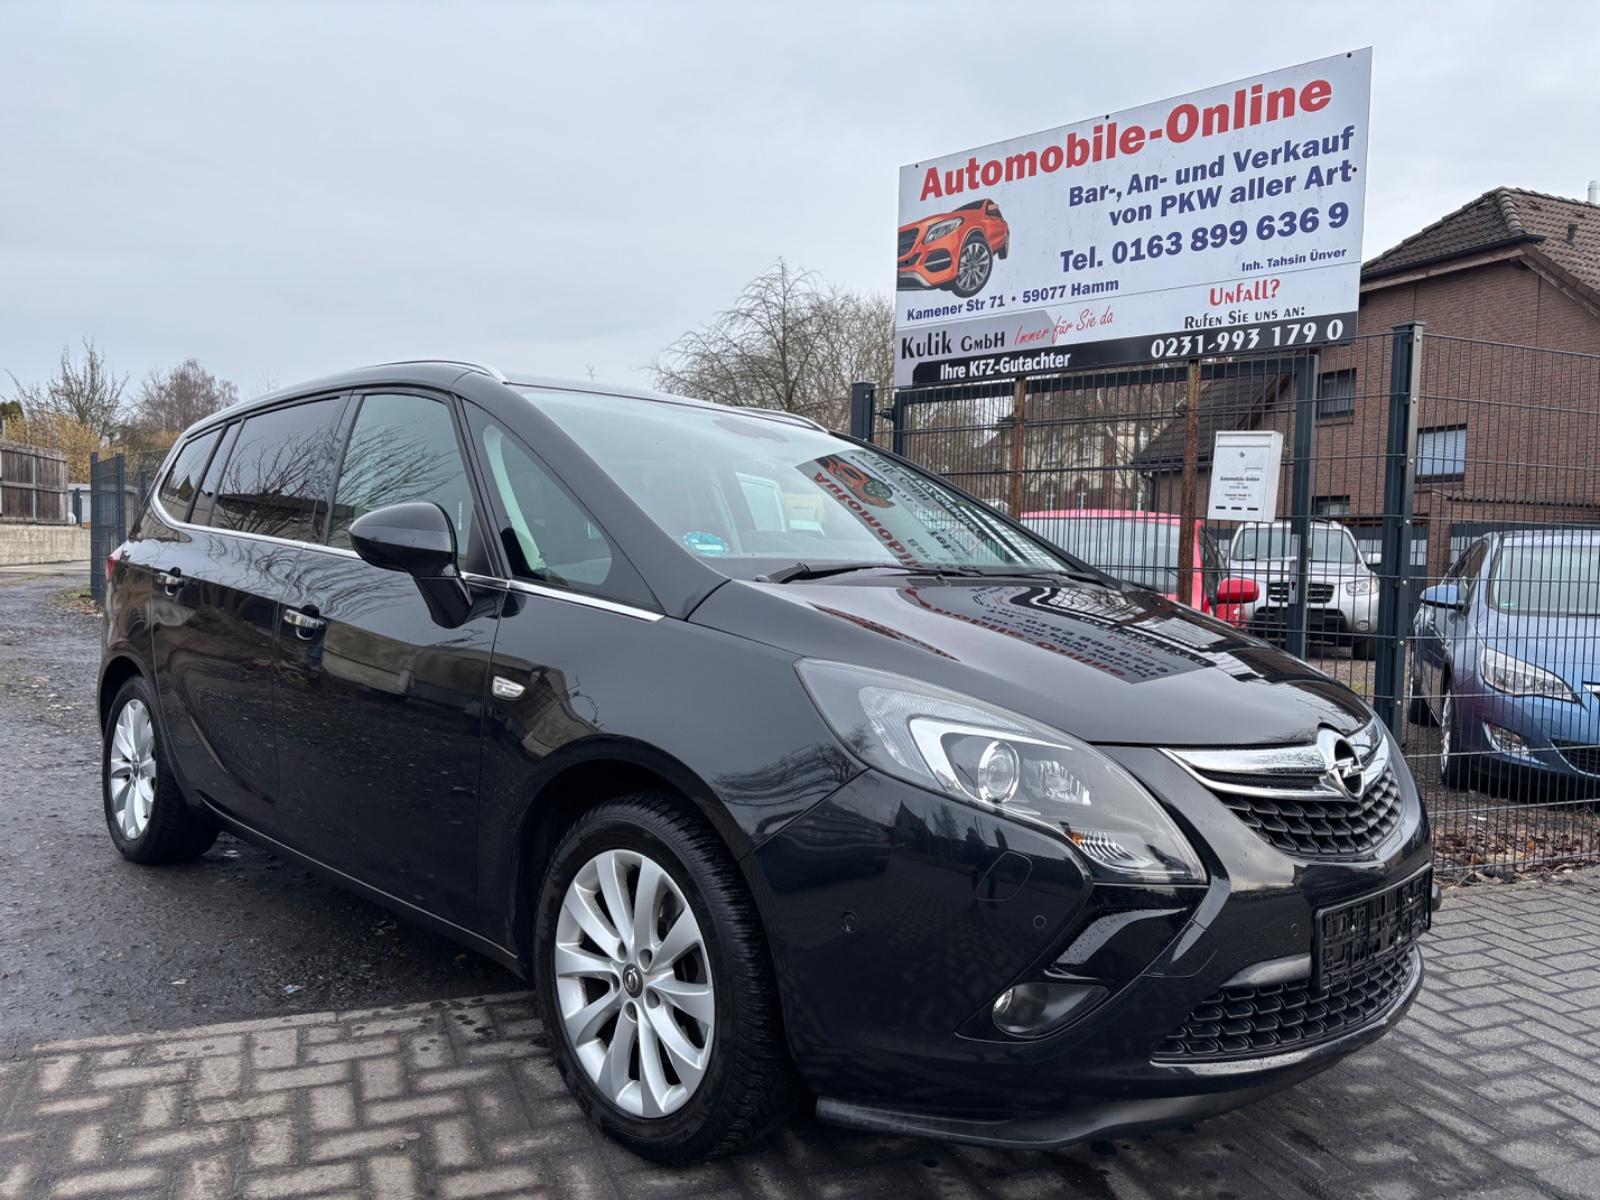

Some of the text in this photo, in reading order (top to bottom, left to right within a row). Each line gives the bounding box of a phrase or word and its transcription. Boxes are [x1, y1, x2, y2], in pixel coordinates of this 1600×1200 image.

[919, 79, 1332, 201] Automobile-Online
[1069, 125, 1355, 207] Bar-, An- und Verkauf
[1109, 159, 1352, 226] von PKW aller Art
[1060, 201, 1349, 272] Tel. 0163 899 636 9
[1241, 248, 1347, 272] Inh. Tahsin Ünver
[907, 279, 1119, 321] Kamener Str 71 59077 Hamm
[901, 330, 953, 360] Kulik
[1014, 304, 1114, 346] Immer für Sie da
[1151, 319, 1344, 359] 0231-993 179 0
[940, 352, 1071, 381] Ihre KFZ-Gutachter
